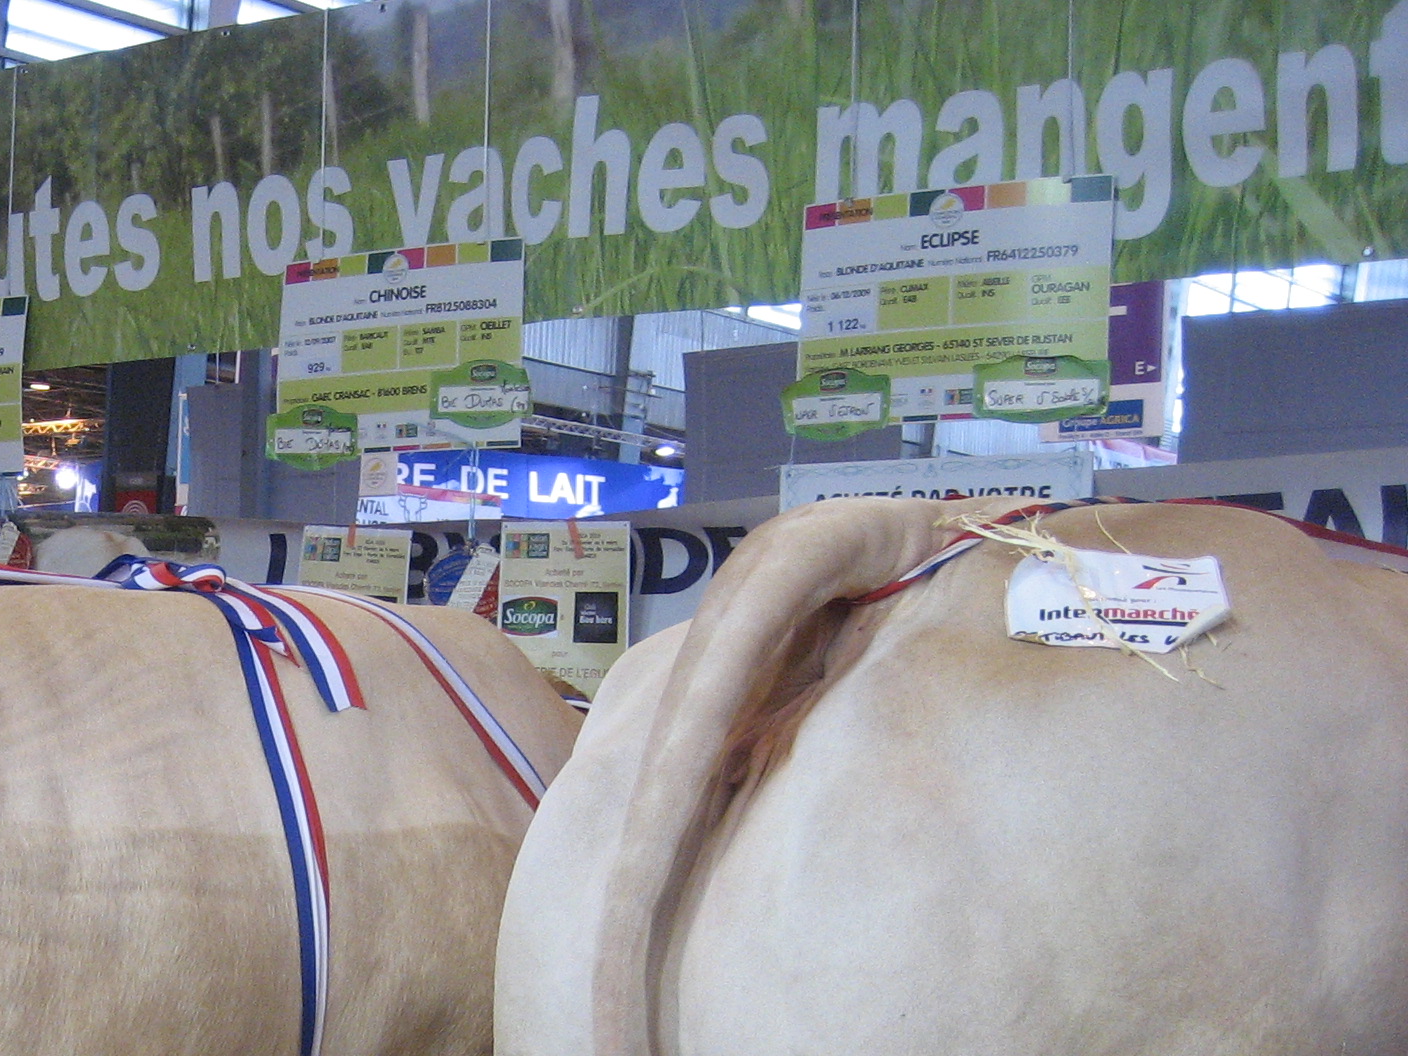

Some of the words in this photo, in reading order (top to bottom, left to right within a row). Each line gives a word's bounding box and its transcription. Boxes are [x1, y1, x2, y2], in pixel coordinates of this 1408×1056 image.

[191, 164, 354, 284] nos
[392, 95, 770, 246] vaches
[920, 230, 980, 249] ECLIPSE
[836, 263, 871, 276] BLONDE
[987, 245, 1079, 262] FR6412250379
[369, 285, 427, 303] CHINOISE
[1031, 281, 1090, 294] OURAGAN
[838, 318, 859, 332] 122
[893, 341, 935, 353] GEORGES
[986, 335, 1014, 346] SEVER
[1016, 335, 1030, 345] DE
[307, 361, 325, 374] 929
[1134, 361, 1145, 376] E
[460, 465, 509, 499] DE
[529, 470, 607, 507] LAIT
[504, 608, 555, 628] Socopa
[559, 667, 573, 678] DE
